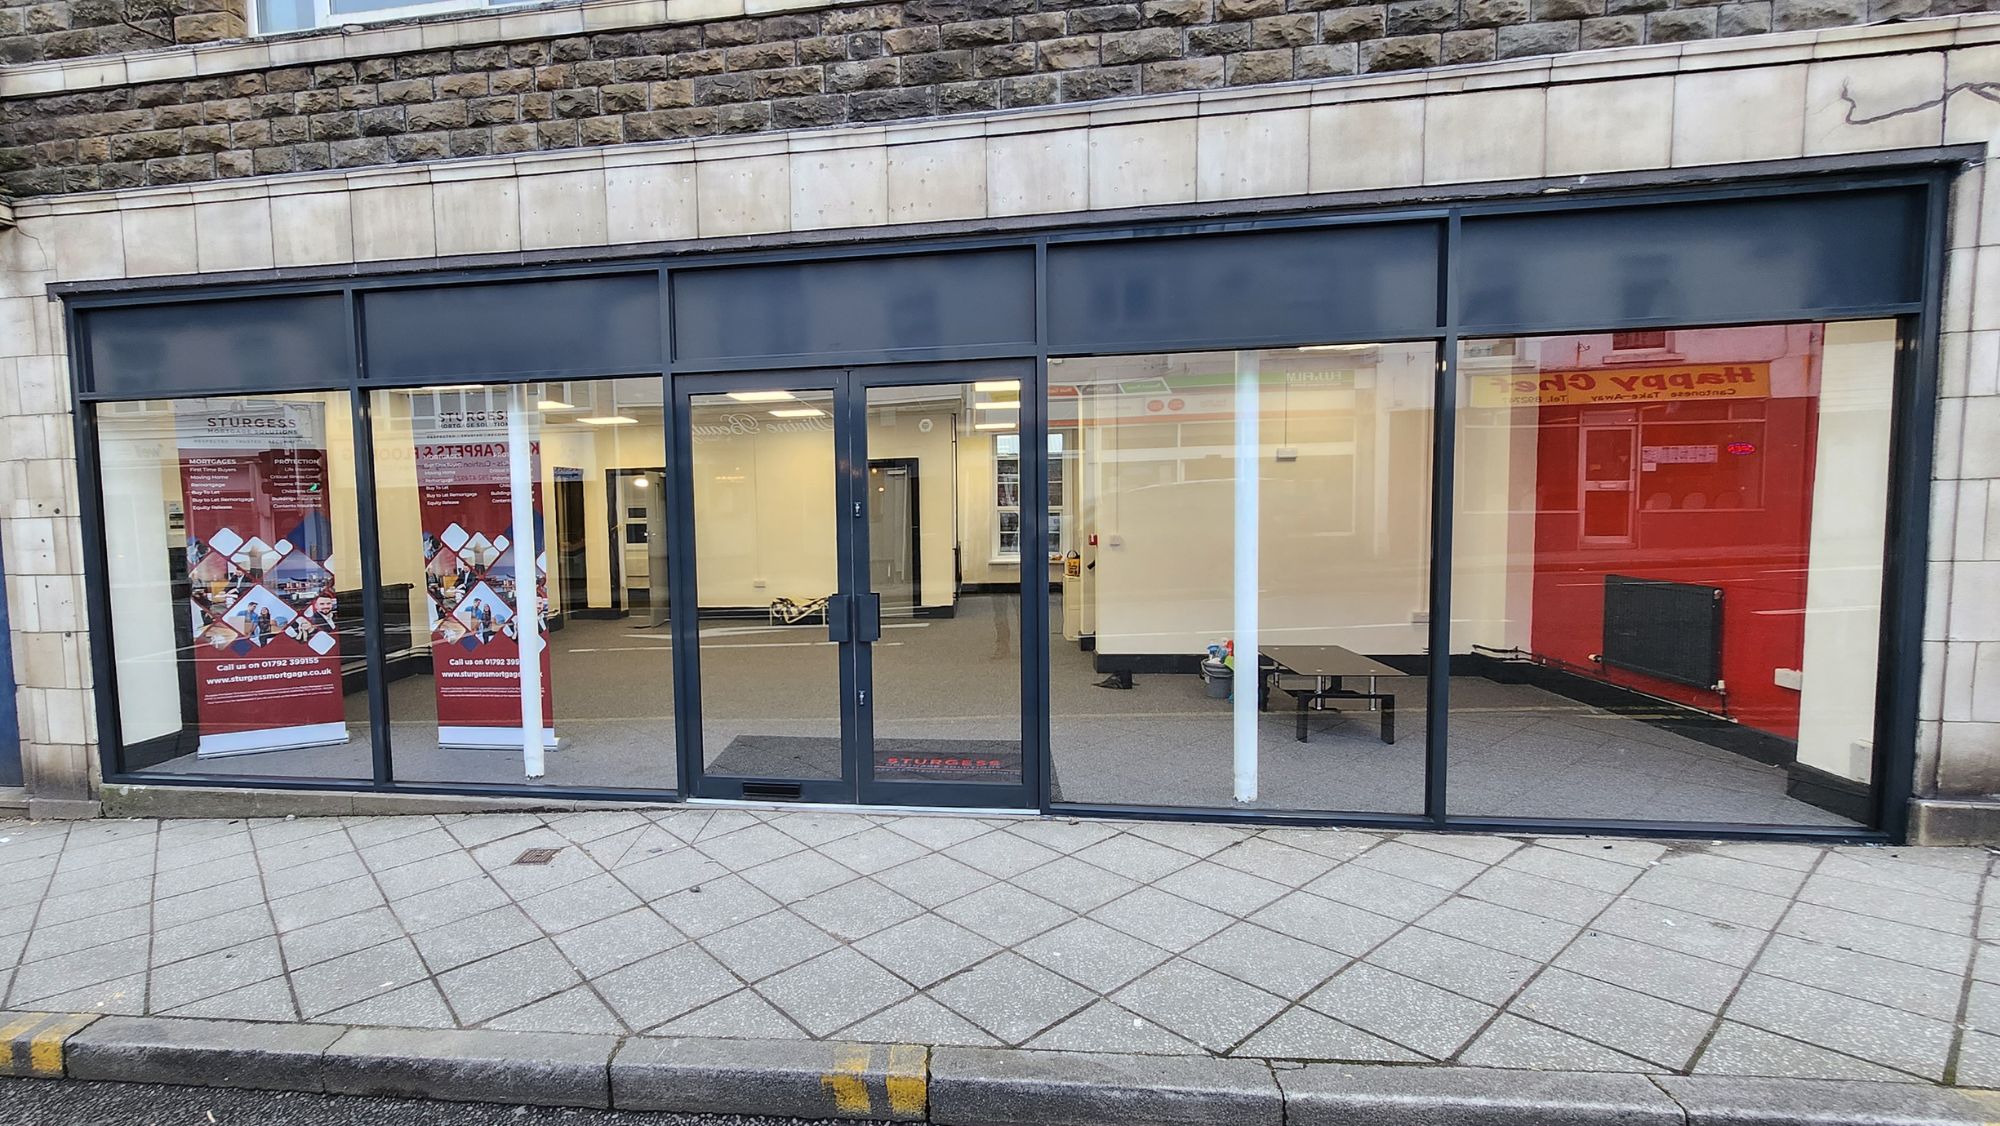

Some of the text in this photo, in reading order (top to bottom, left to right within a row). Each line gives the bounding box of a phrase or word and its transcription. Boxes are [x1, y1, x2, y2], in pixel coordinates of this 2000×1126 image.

[207, 417, 296, 428] STURGESS
[216, 664, 234, 672] Call
[261, 659, 288, 668] 01792
[289, 657, 319, 666] 399155
[449, 658, 464, 666] Call
[484, 658, 506, 666] 01792
[206, 668, 332, 685] www.sturgessmortgage.co.uk
[887, 757, 1001, 766] STURGESS
